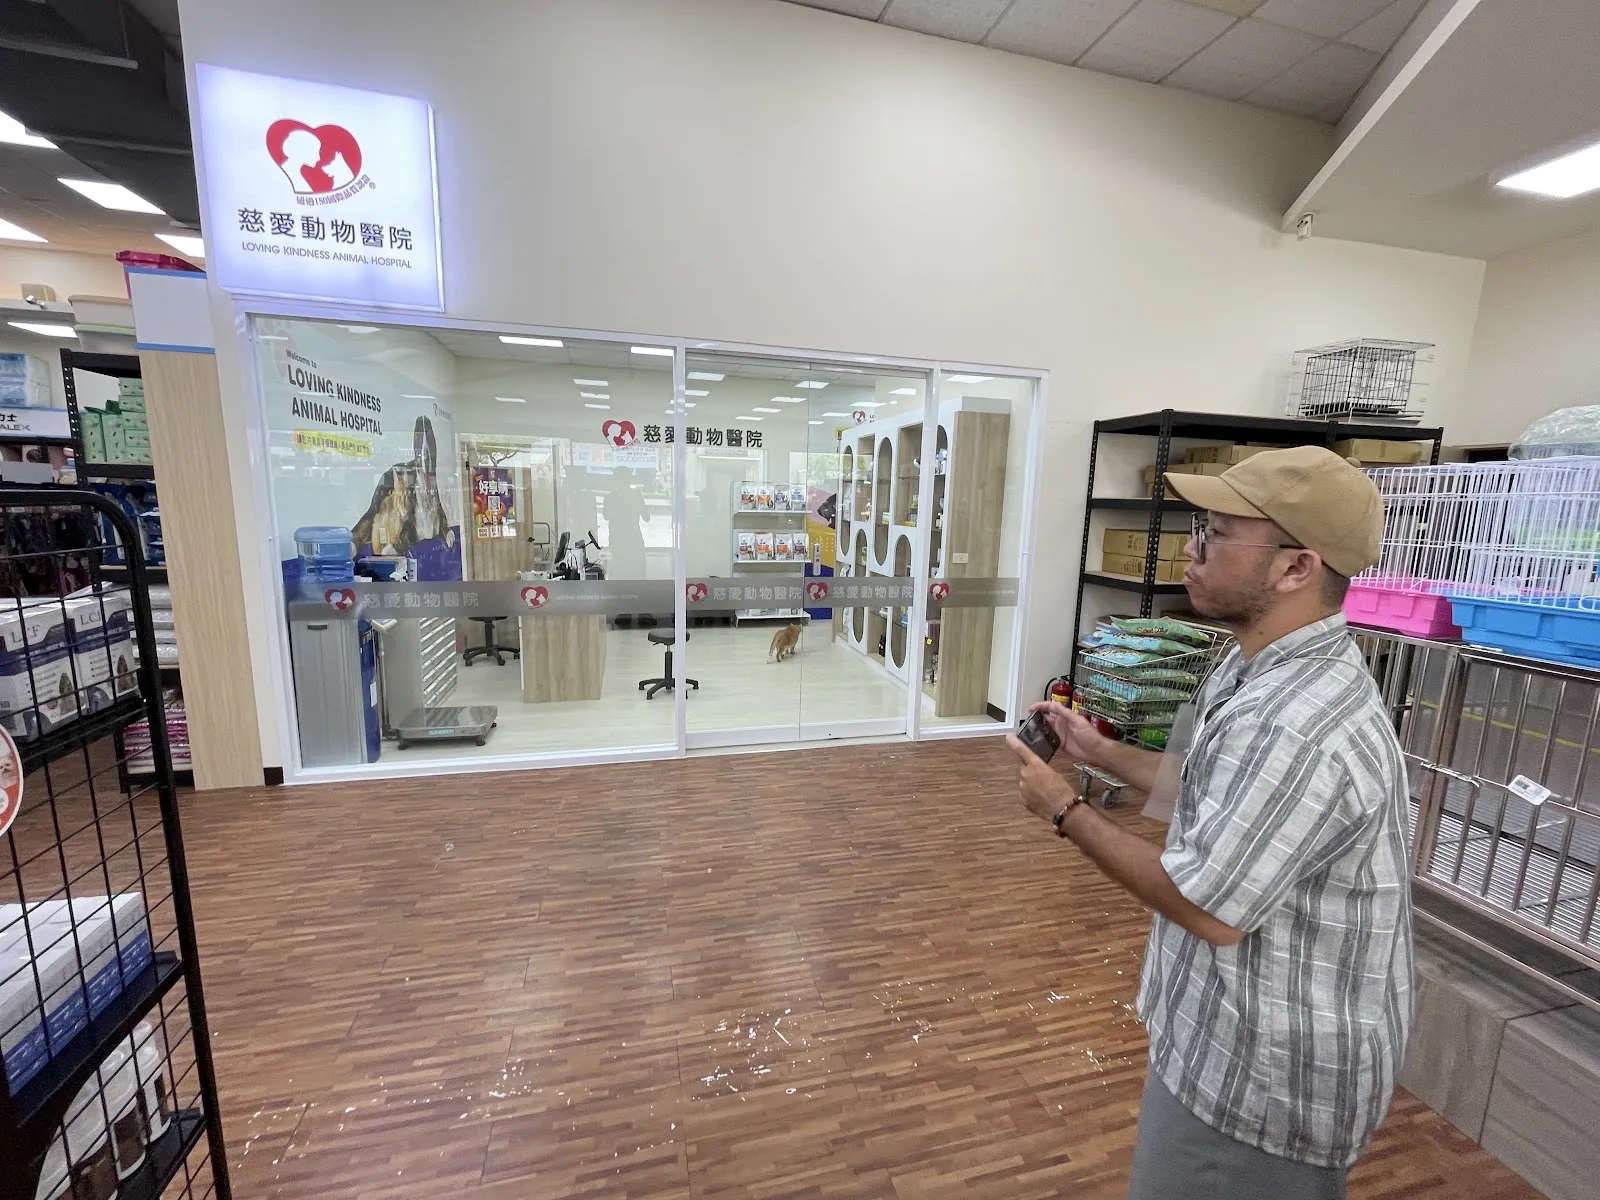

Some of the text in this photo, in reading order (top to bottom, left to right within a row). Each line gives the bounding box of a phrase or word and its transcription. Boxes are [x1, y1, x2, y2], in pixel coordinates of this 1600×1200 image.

[238, 207, 413, 251] 慈愛動物醫院
[242, 241, 412, 269] LOVING KINDNESS ANIMAL HOSPITAL
[286, 348, 317, 369] Welcome to
[288, 364, 381, 413] LOVING KINDNESS
[292, 396, 383, 436] ANIMAL HOSPITAL
[362, 591, 480, 608] 慈愛動物醫院
[712, 585, 802, 600] 慈愛動物醫院
[832, 585, 914, 599] 慈愛動物醫院
